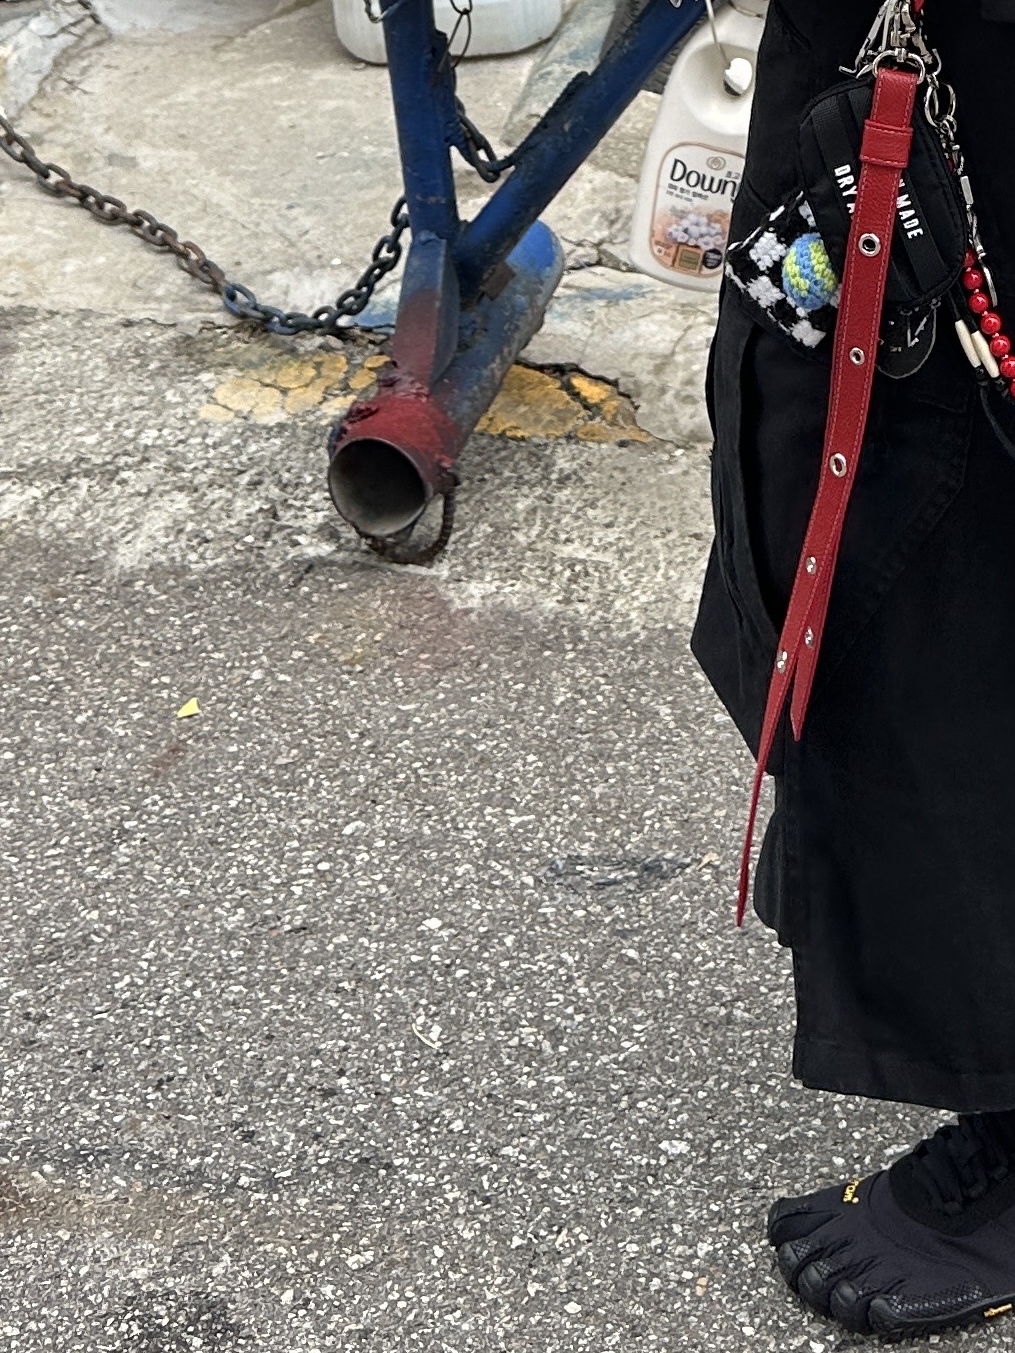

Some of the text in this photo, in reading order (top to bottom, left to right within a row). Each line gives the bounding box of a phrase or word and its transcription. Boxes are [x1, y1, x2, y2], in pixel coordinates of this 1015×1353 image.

[670, 158, 740, 204] Down
[834, 164, 858, 202] DRY
[896, 196, 923, 240] MADE
